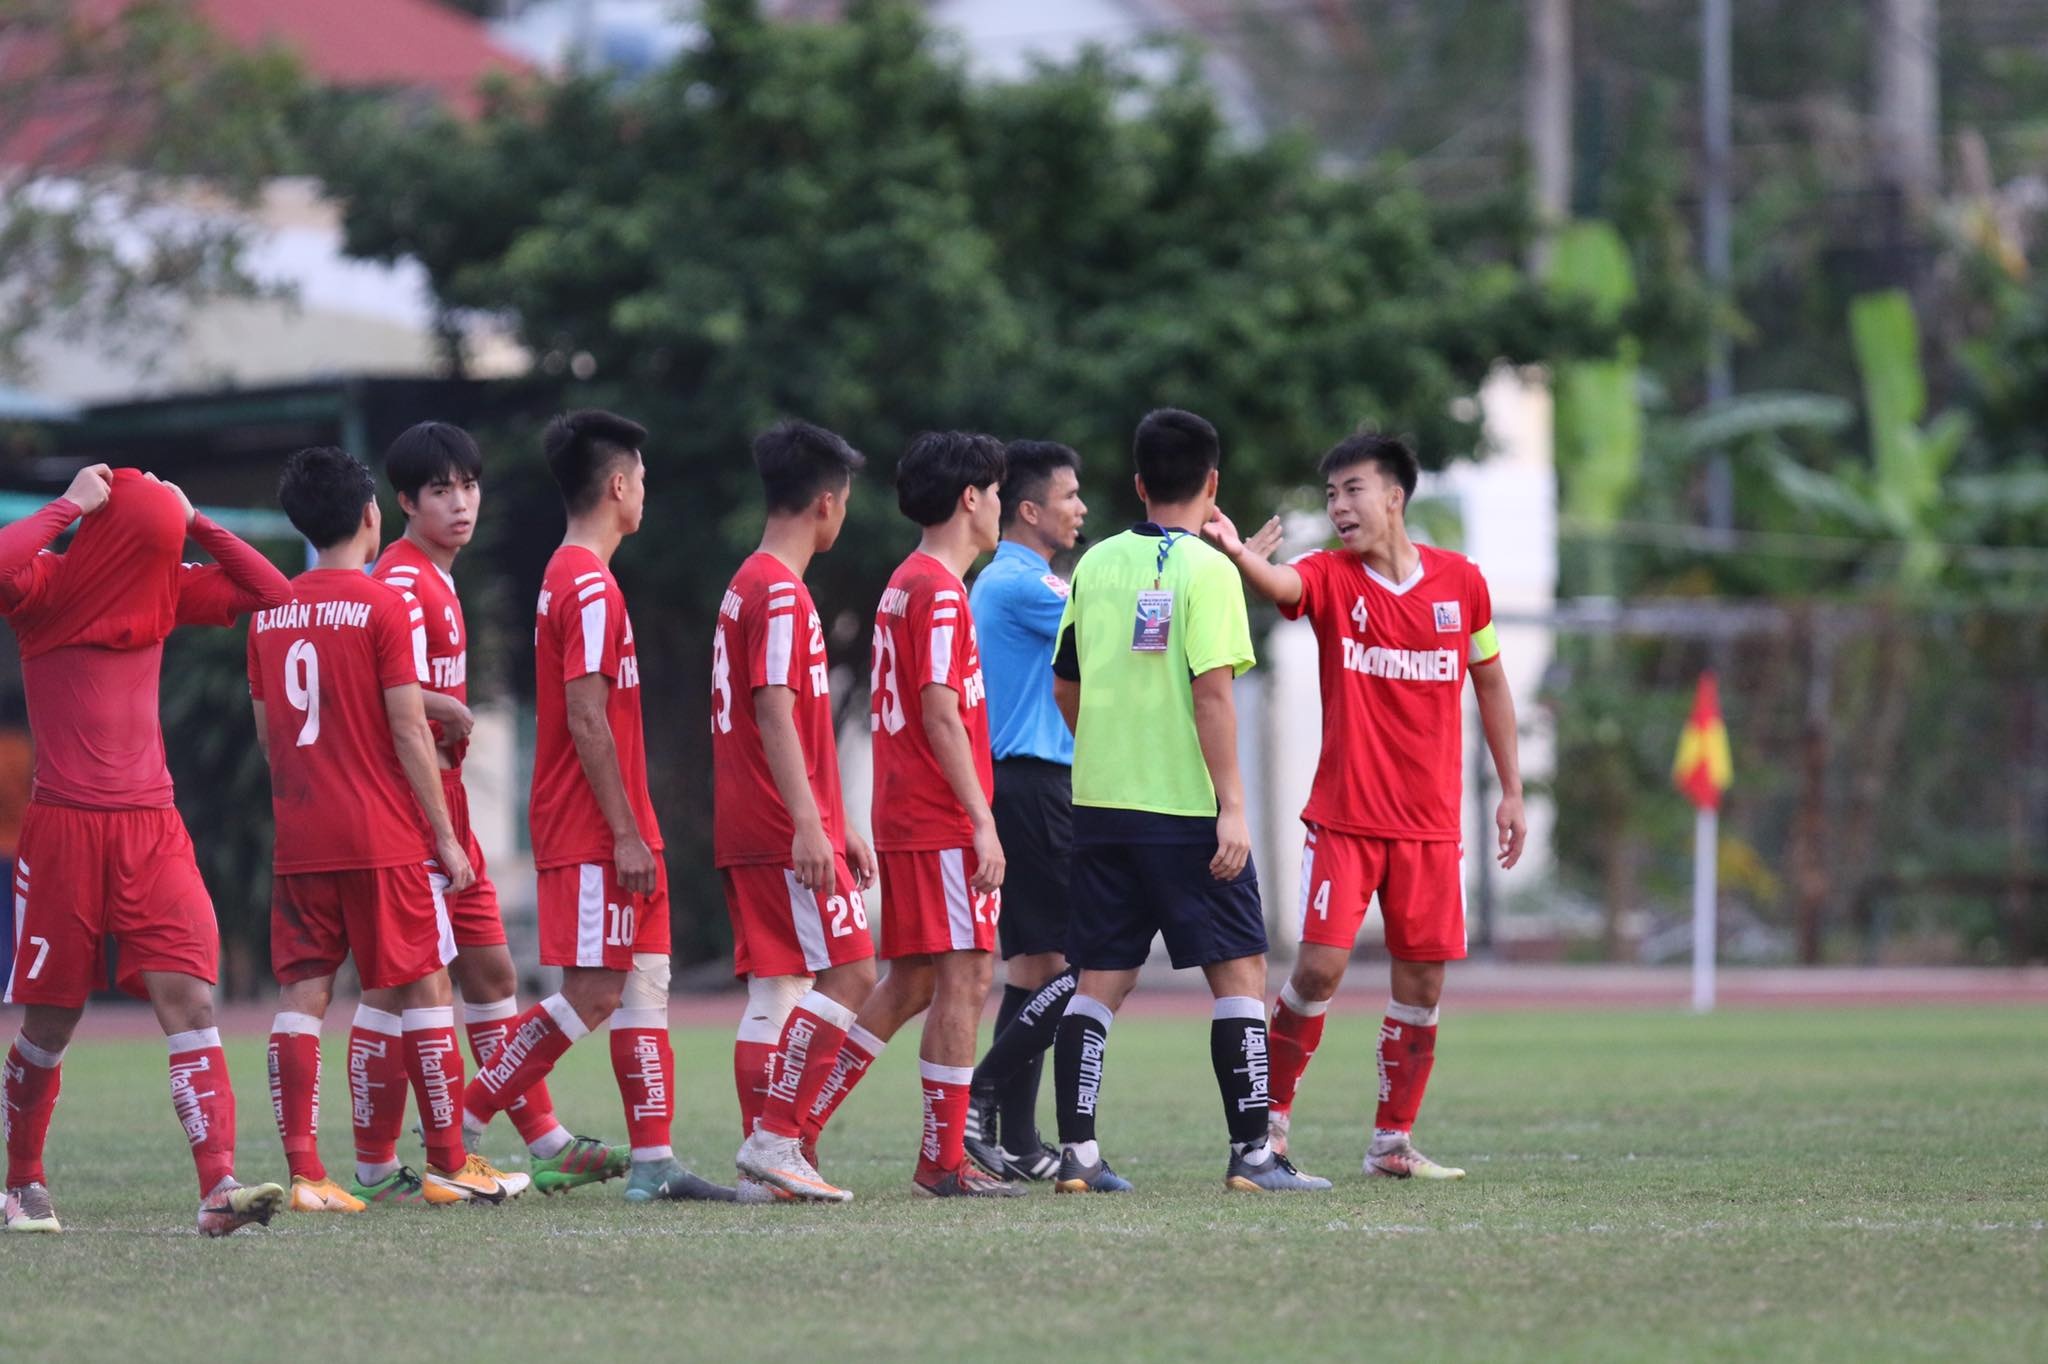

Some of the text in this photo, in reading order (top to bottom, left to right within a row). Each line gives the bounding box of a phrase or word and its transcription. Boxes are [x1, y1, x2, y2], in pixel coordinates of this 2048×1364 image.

[256, 598, 371, 634] B.XUÂN THỊNH
[444, 606, 460, 645] 3
[1351, 595, 1368, 633] 4
[285, 639, 319, 746] 9
[826, 891, 868, 938] 28
[970, 886, 1001, 926] 23
[1313, 880, 1331, 920] 4
[606, 903, 634, 947] 10
[26, 936, 50, 980] 7
